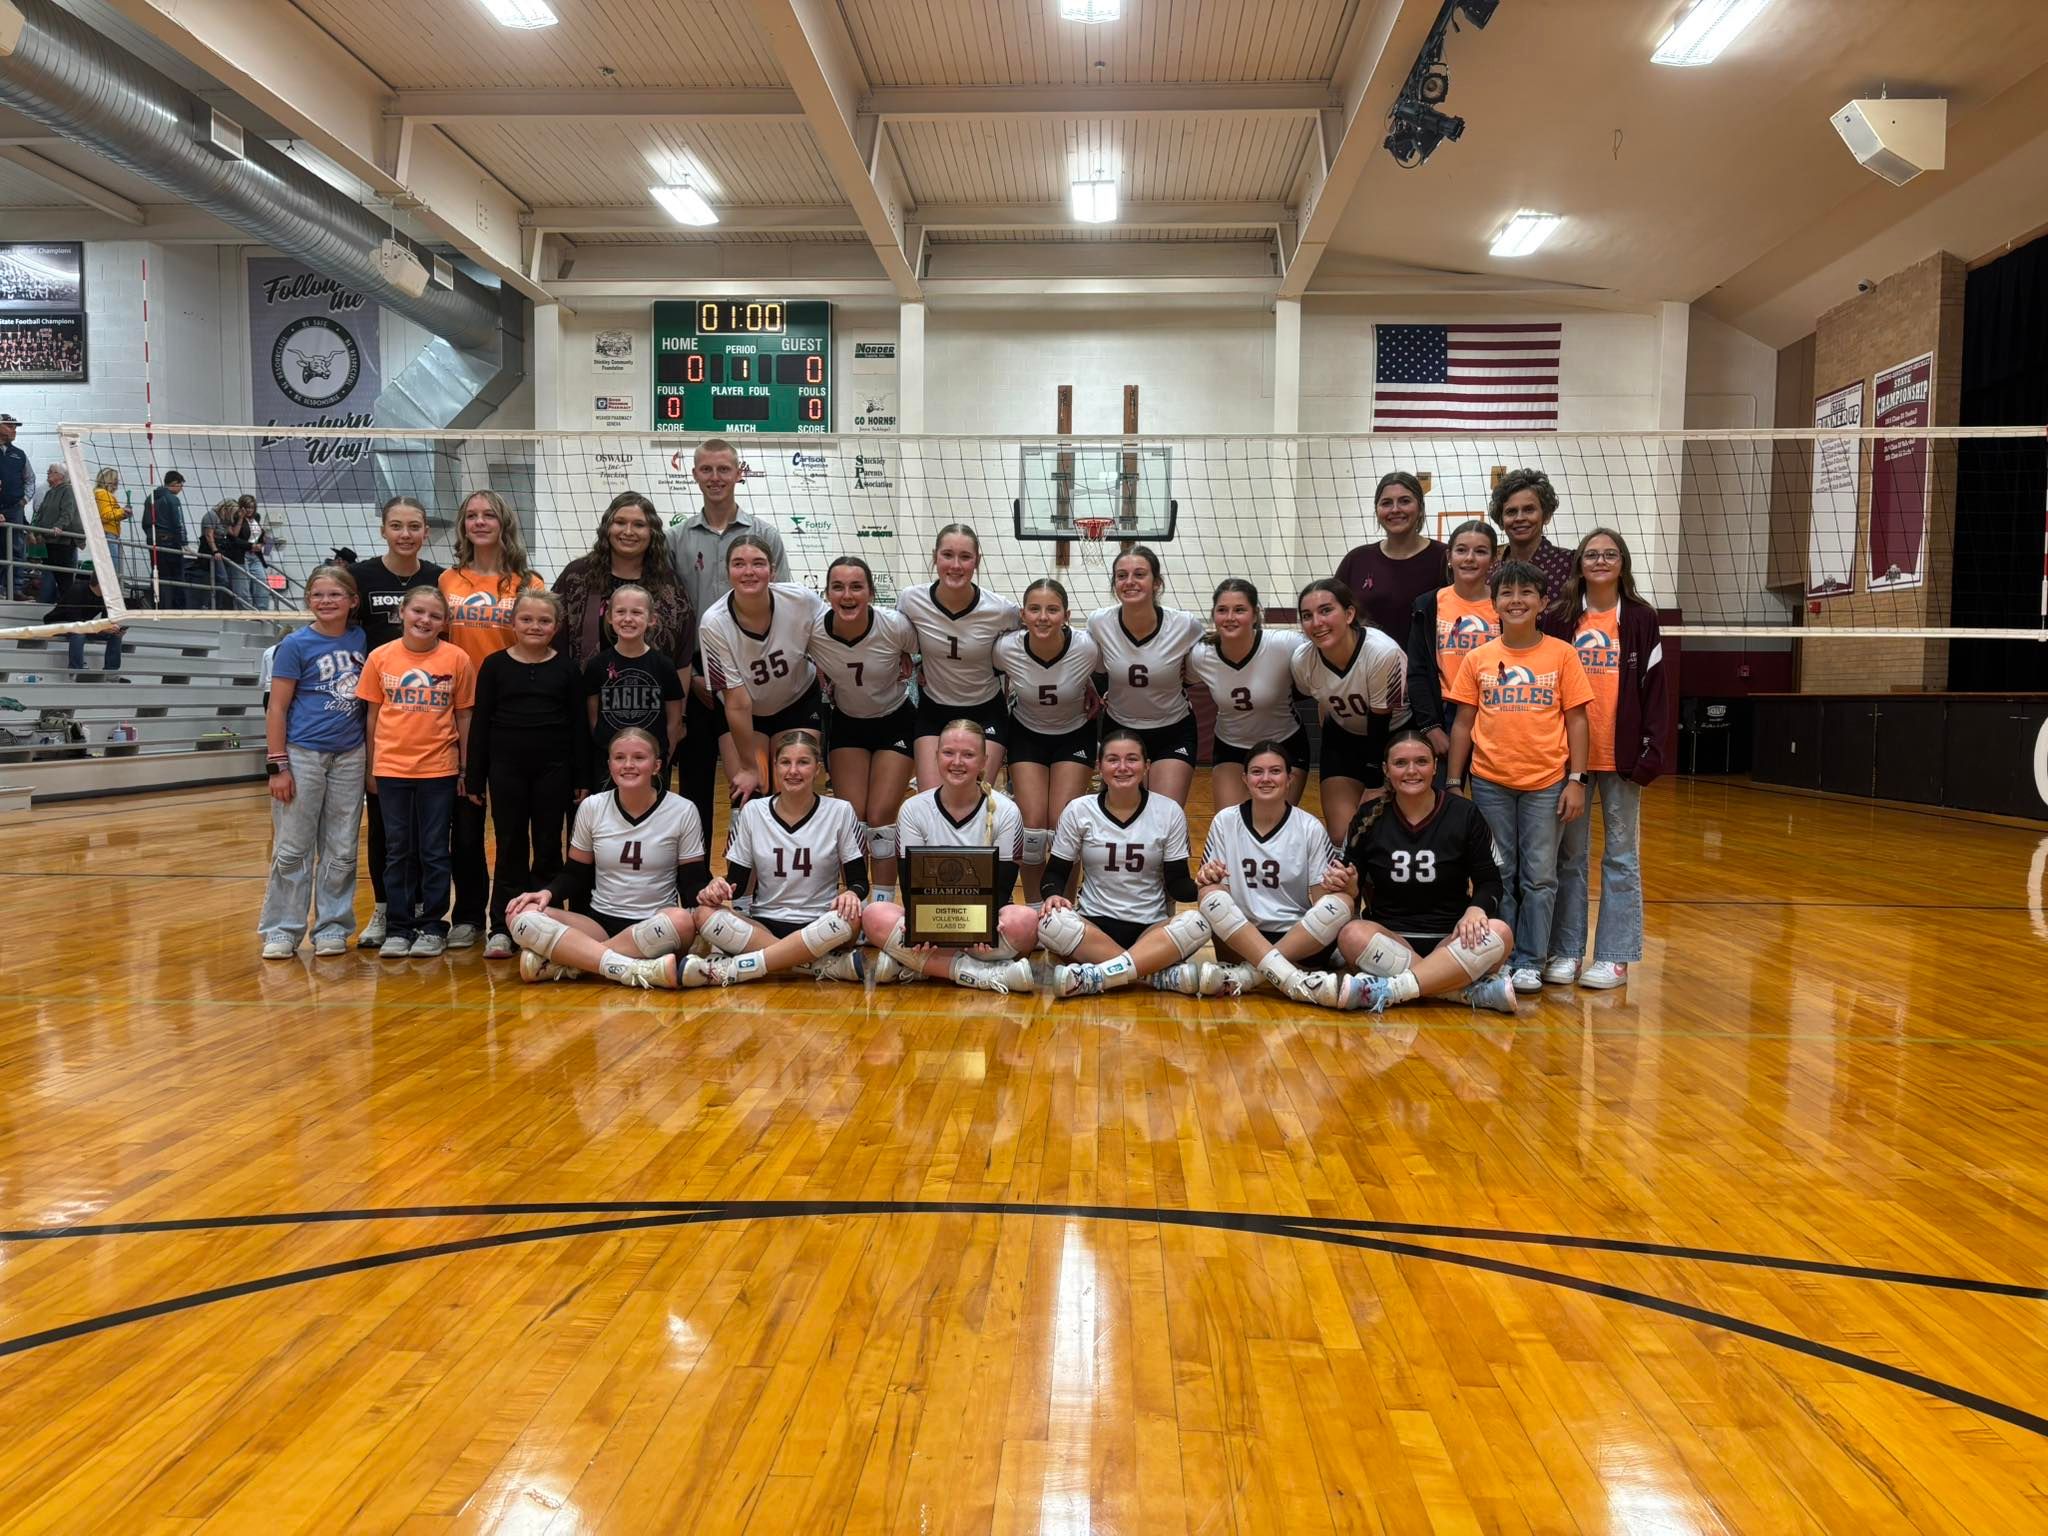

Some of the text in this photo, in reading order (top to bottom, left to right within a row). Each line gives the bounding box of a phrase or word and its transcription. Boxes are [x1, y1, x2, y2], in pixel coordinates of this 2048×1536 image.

[38, 247, 72, 255] Champions
[263, 273, 344, 304] Follow
[329, 290, 365, 312] the
[41, 318, 75, 326] Champions
[702, 304, 781, 331] 01:00
[662, 337, 699, 350] HOME
[726, 345, 757, 354] PERIOD
[782, 338, 823, 351] GUEST
[855, 343, 895, 353] NORDER
[687, 355, 704, 382] 0
[742, 359, 748, 378] 1
[806, 356, 823, 382] 0
[657, 386, 685, 395] FOULS
[1893, 374, 1912, 388] STATE
[711, 387, 771, 396] PLAYER FOUL
[798, 387, 826, 396] FOULS
[1876, 380, 1929, 418] CHAMPIONSHIP
[667, 397, 681, 418] 0
[808, 398, 822, 419] 0
[1848, 404, 1860, 425] UP
[657, 423, 685, 432] SCORE
[726, 424, 757, 433] MATCH
[798, 425, 825, 433] SCORE
[854, 416, 896, 426] GO HORNS!
[304, 438, 372, 465] Way!
[595, 454, 633, 463] OSWALD
[793, 452, 826, 466] Carlson
[855, 467, 883, 479] Parents
[855, 478, 893, 490] Association
[805, 521, 831, 530] Fortify
[372, 595, 405, 606] HOM
[947, 635, 962, 661] 1
[750, 649, 789, 687] 35
[847, 661, 864, 687] 7
[1128, 664, 1149, 688] 6
[385, 687, 450, 707] EAGLES
[601, 687, 661, 710] EAGLES
[1038, 684, 1058, 706] 5
[1230, 687, 1253, 712] 3
[1482, 687, 1553, 706] EAGLES
[1329, 693, 1368, 718] 20
[619, 840, 643, 871] 4
[773, 847, 812, 878] 14
[1104, 842, 1145, 873] 15
[1242, 858, 1281, 889] 23
[1390, 850, 1437, 883] 33
